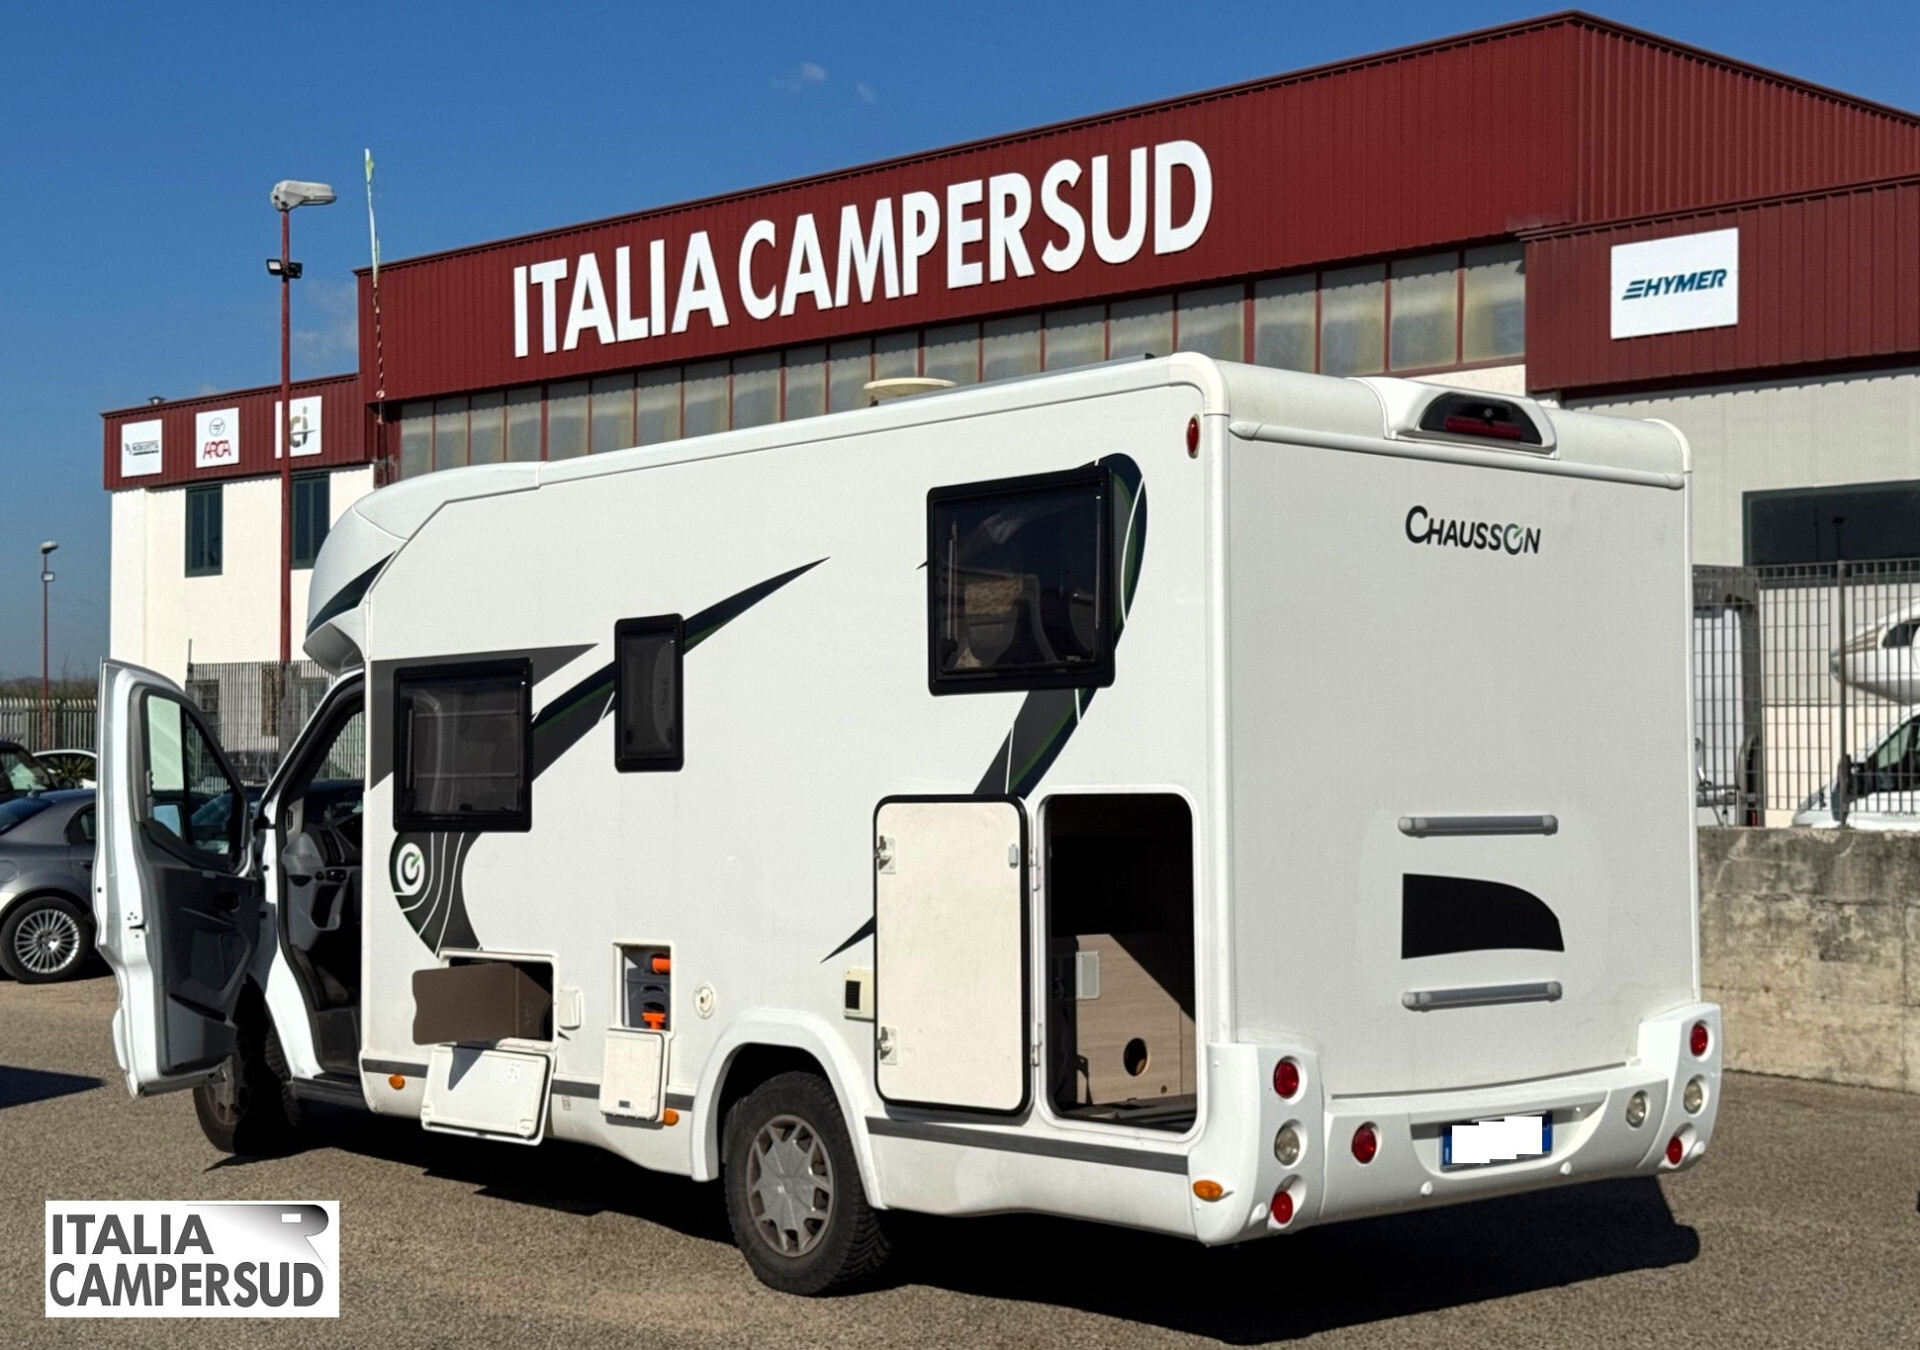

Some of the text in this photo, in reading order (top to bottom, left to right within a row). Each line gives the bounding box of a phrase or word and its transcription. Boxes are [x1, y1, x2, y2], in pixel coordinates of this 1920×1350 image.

[513, 140, 1213, 358] ITALIA CAMPERSUD
[1643, 268, 1727, 298] HYMER
[202, 439, 232, 460] ARCA
